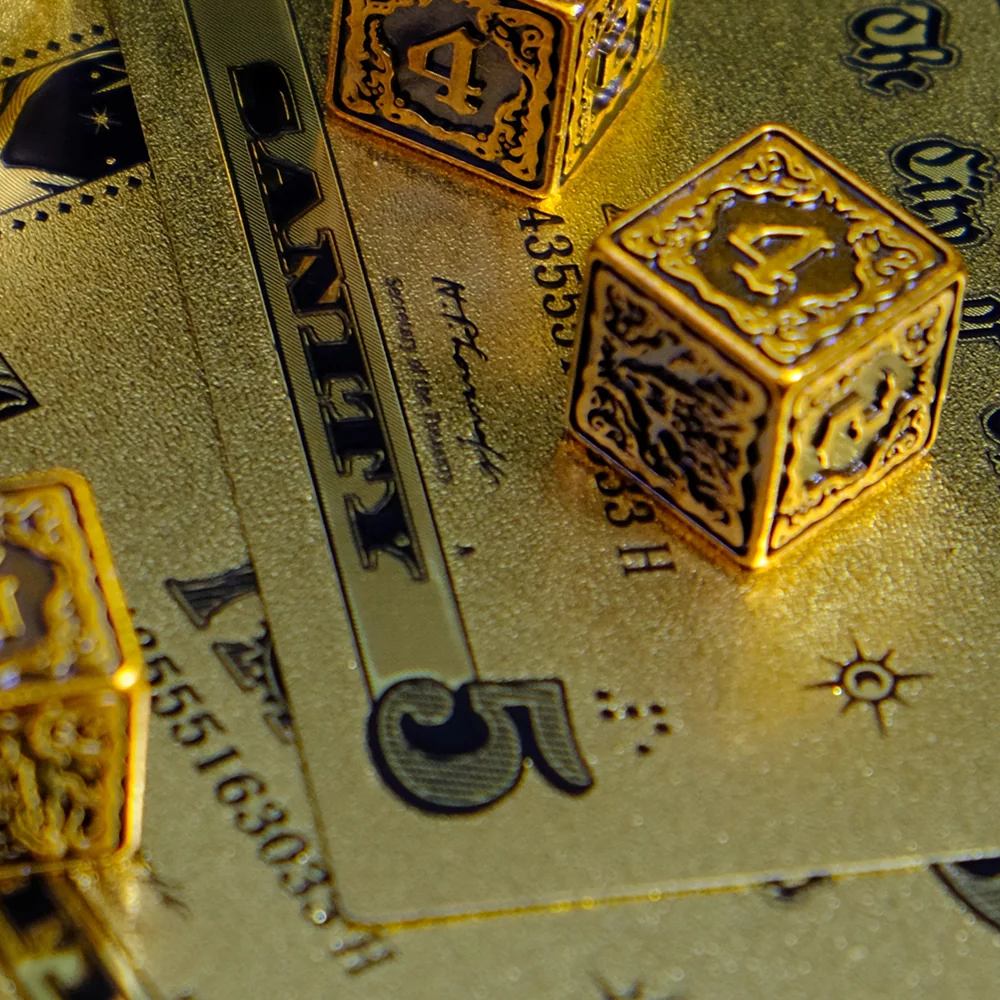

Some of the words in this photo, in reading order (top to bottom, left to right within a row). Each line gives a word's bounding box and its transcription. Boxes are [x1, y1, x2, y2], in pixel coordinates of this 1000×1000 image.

[406, 25, 487, 117] 4
[727, 223, 837, 298] 4
[227, 60, 428, 581] SANITY
[618, 542, 676, 577] H
[367, 677, 595, 816] 5
